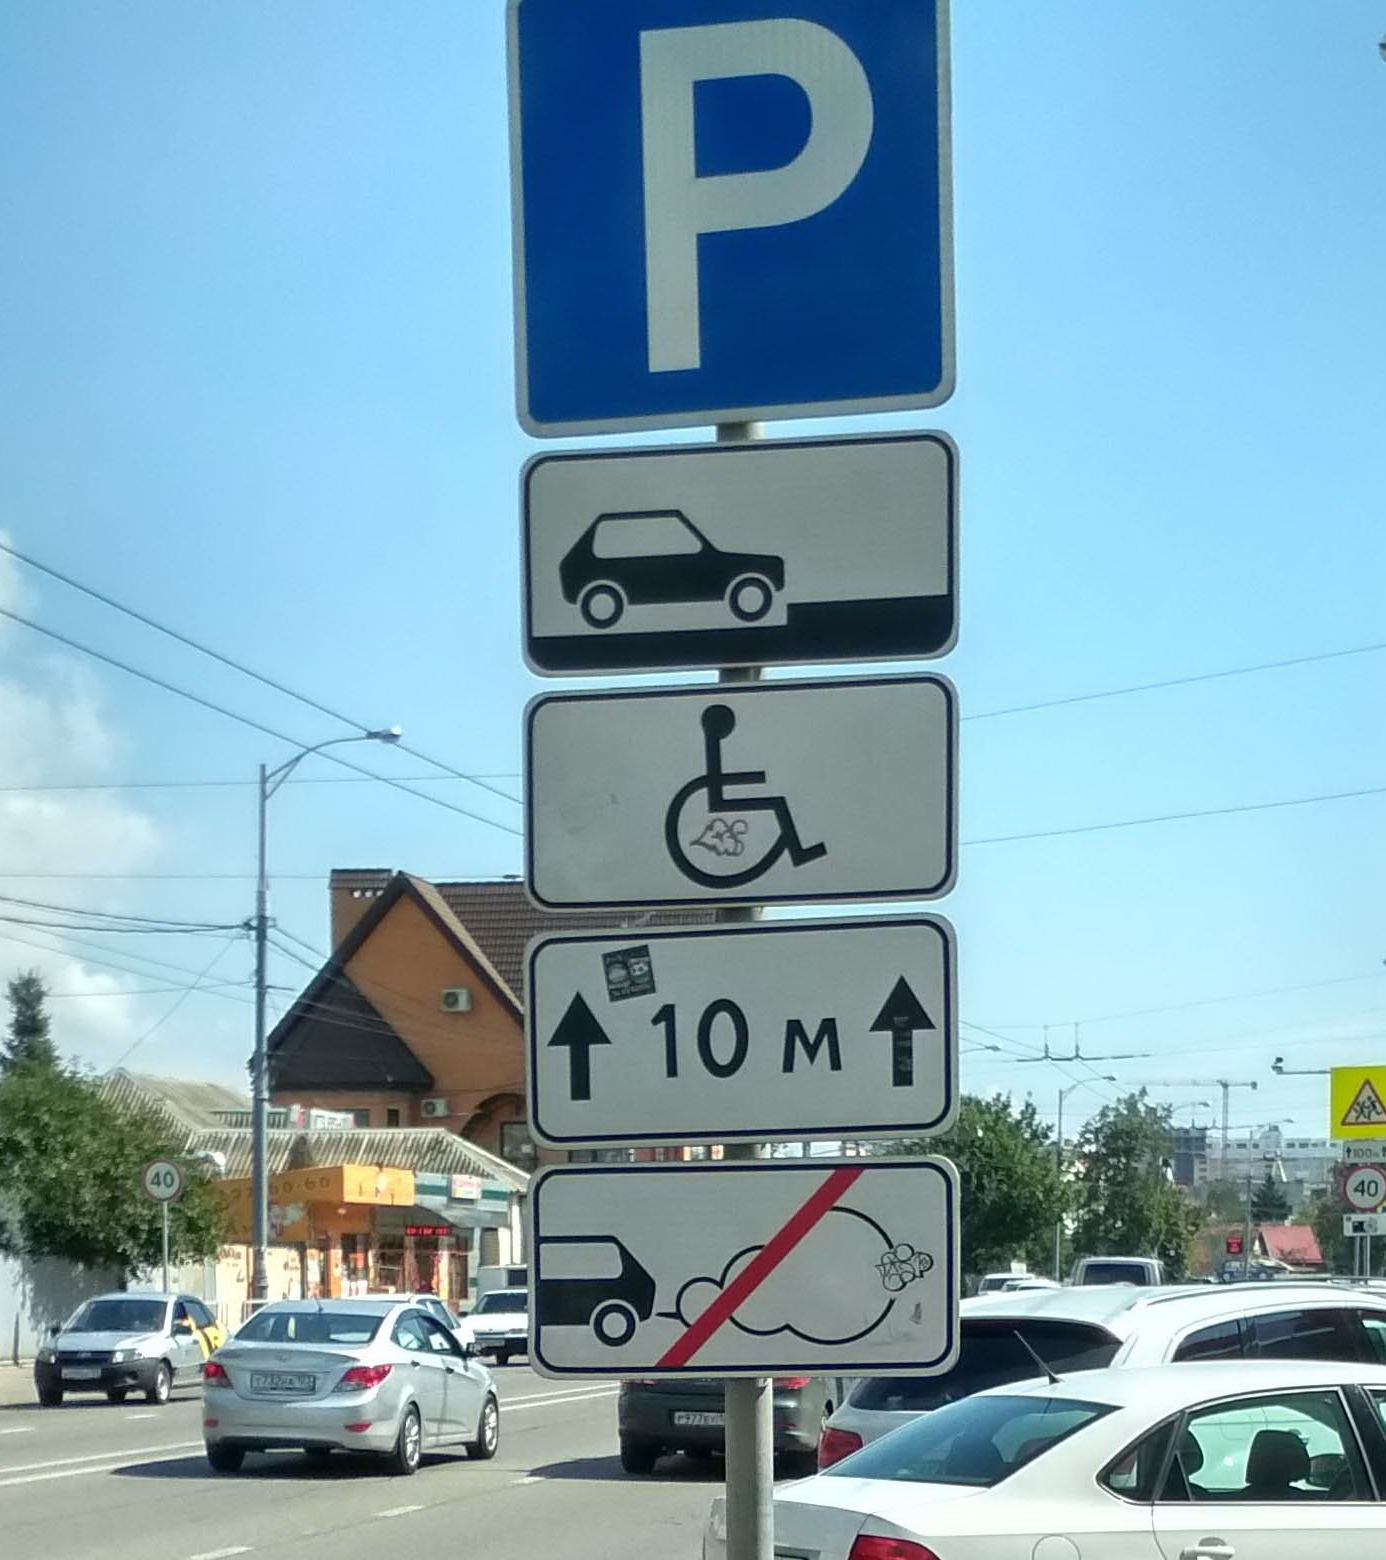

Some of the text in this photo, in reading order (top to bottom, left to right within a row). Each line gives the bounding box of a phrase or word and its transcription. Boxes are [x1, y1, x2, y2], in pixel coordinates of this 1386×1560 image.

[640, 18, 874, 373] P
[651, 997, 750, 1079] 10
[1353, 1147, 1373, 1159] 100
[150, 1170, 175, 1189] 40
[1353, 1179, 1379, 1197] 40
